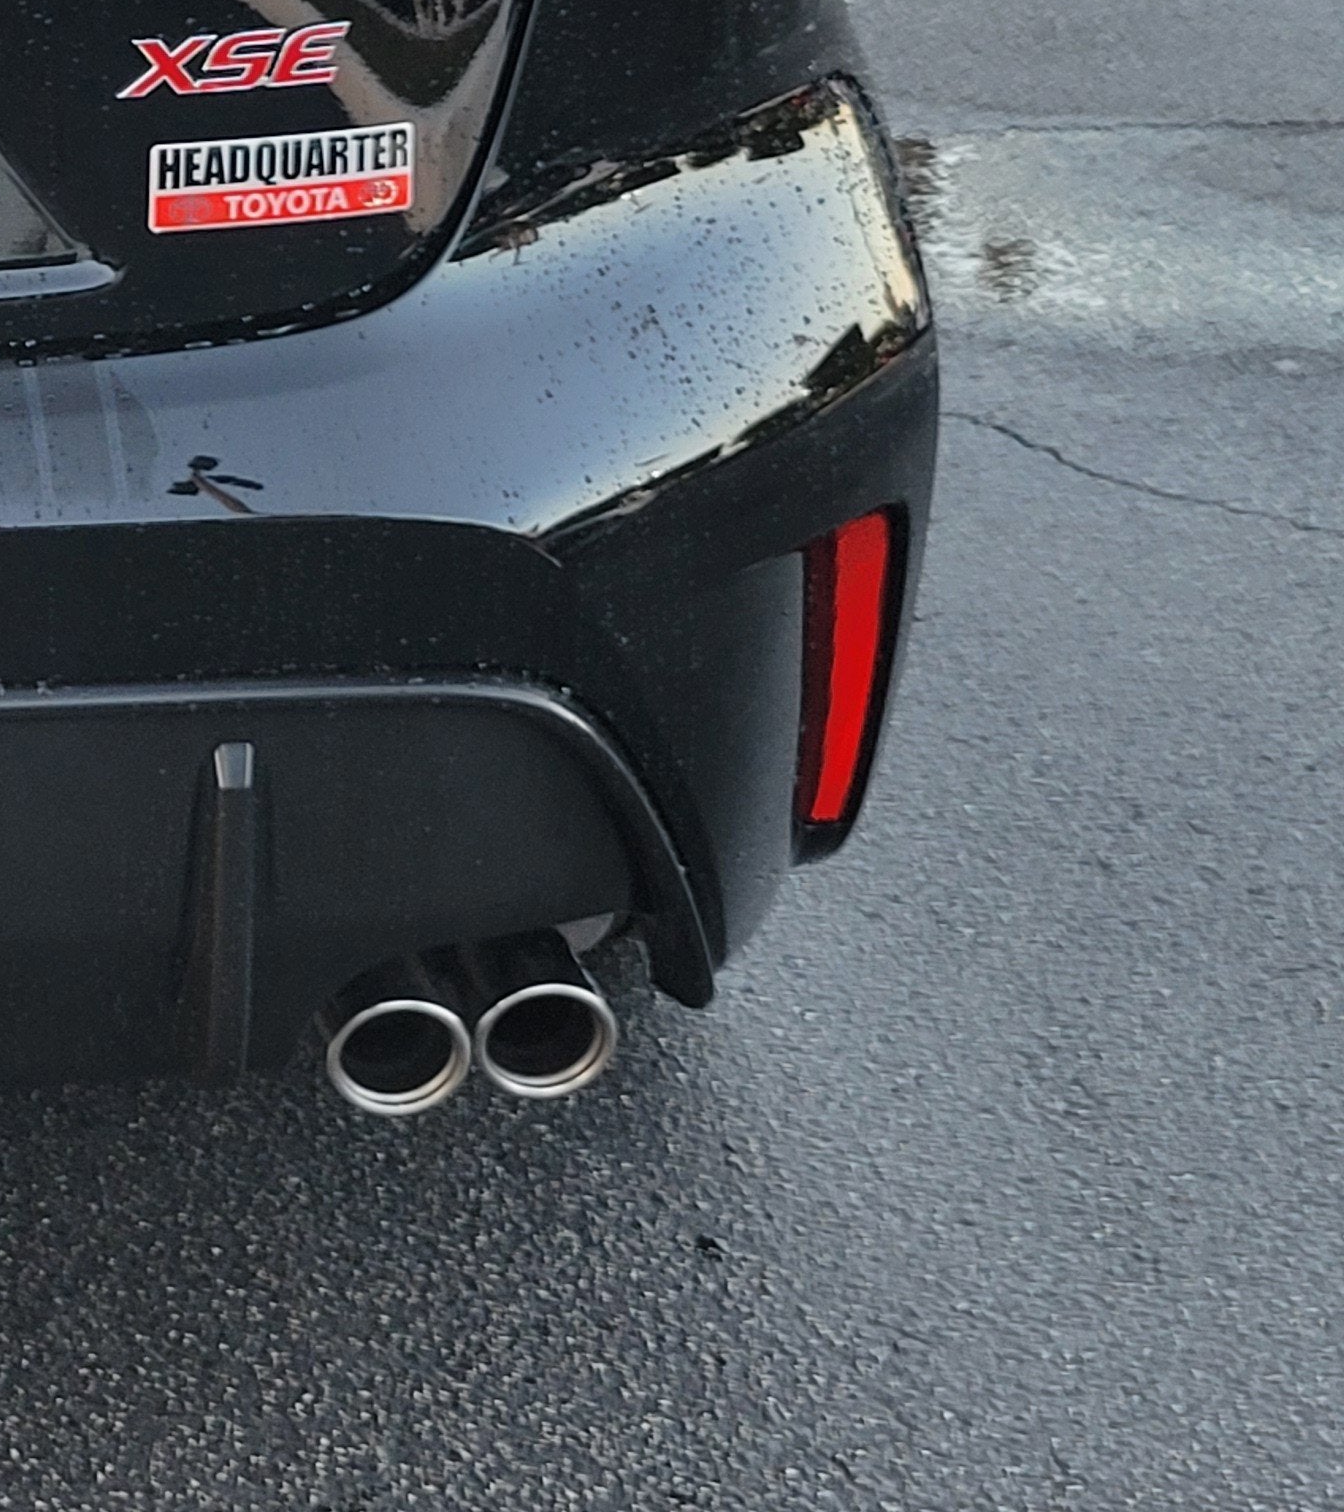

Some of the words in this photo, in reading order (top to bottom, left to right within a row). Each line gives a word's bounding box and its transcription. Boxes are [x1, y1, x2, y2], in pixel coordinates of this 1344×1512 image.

[115, 20, 352, 100] XSE
[158, 129, 409, 190] HEADQUARTER
[223, 185, 349, 220] TOYOTA
